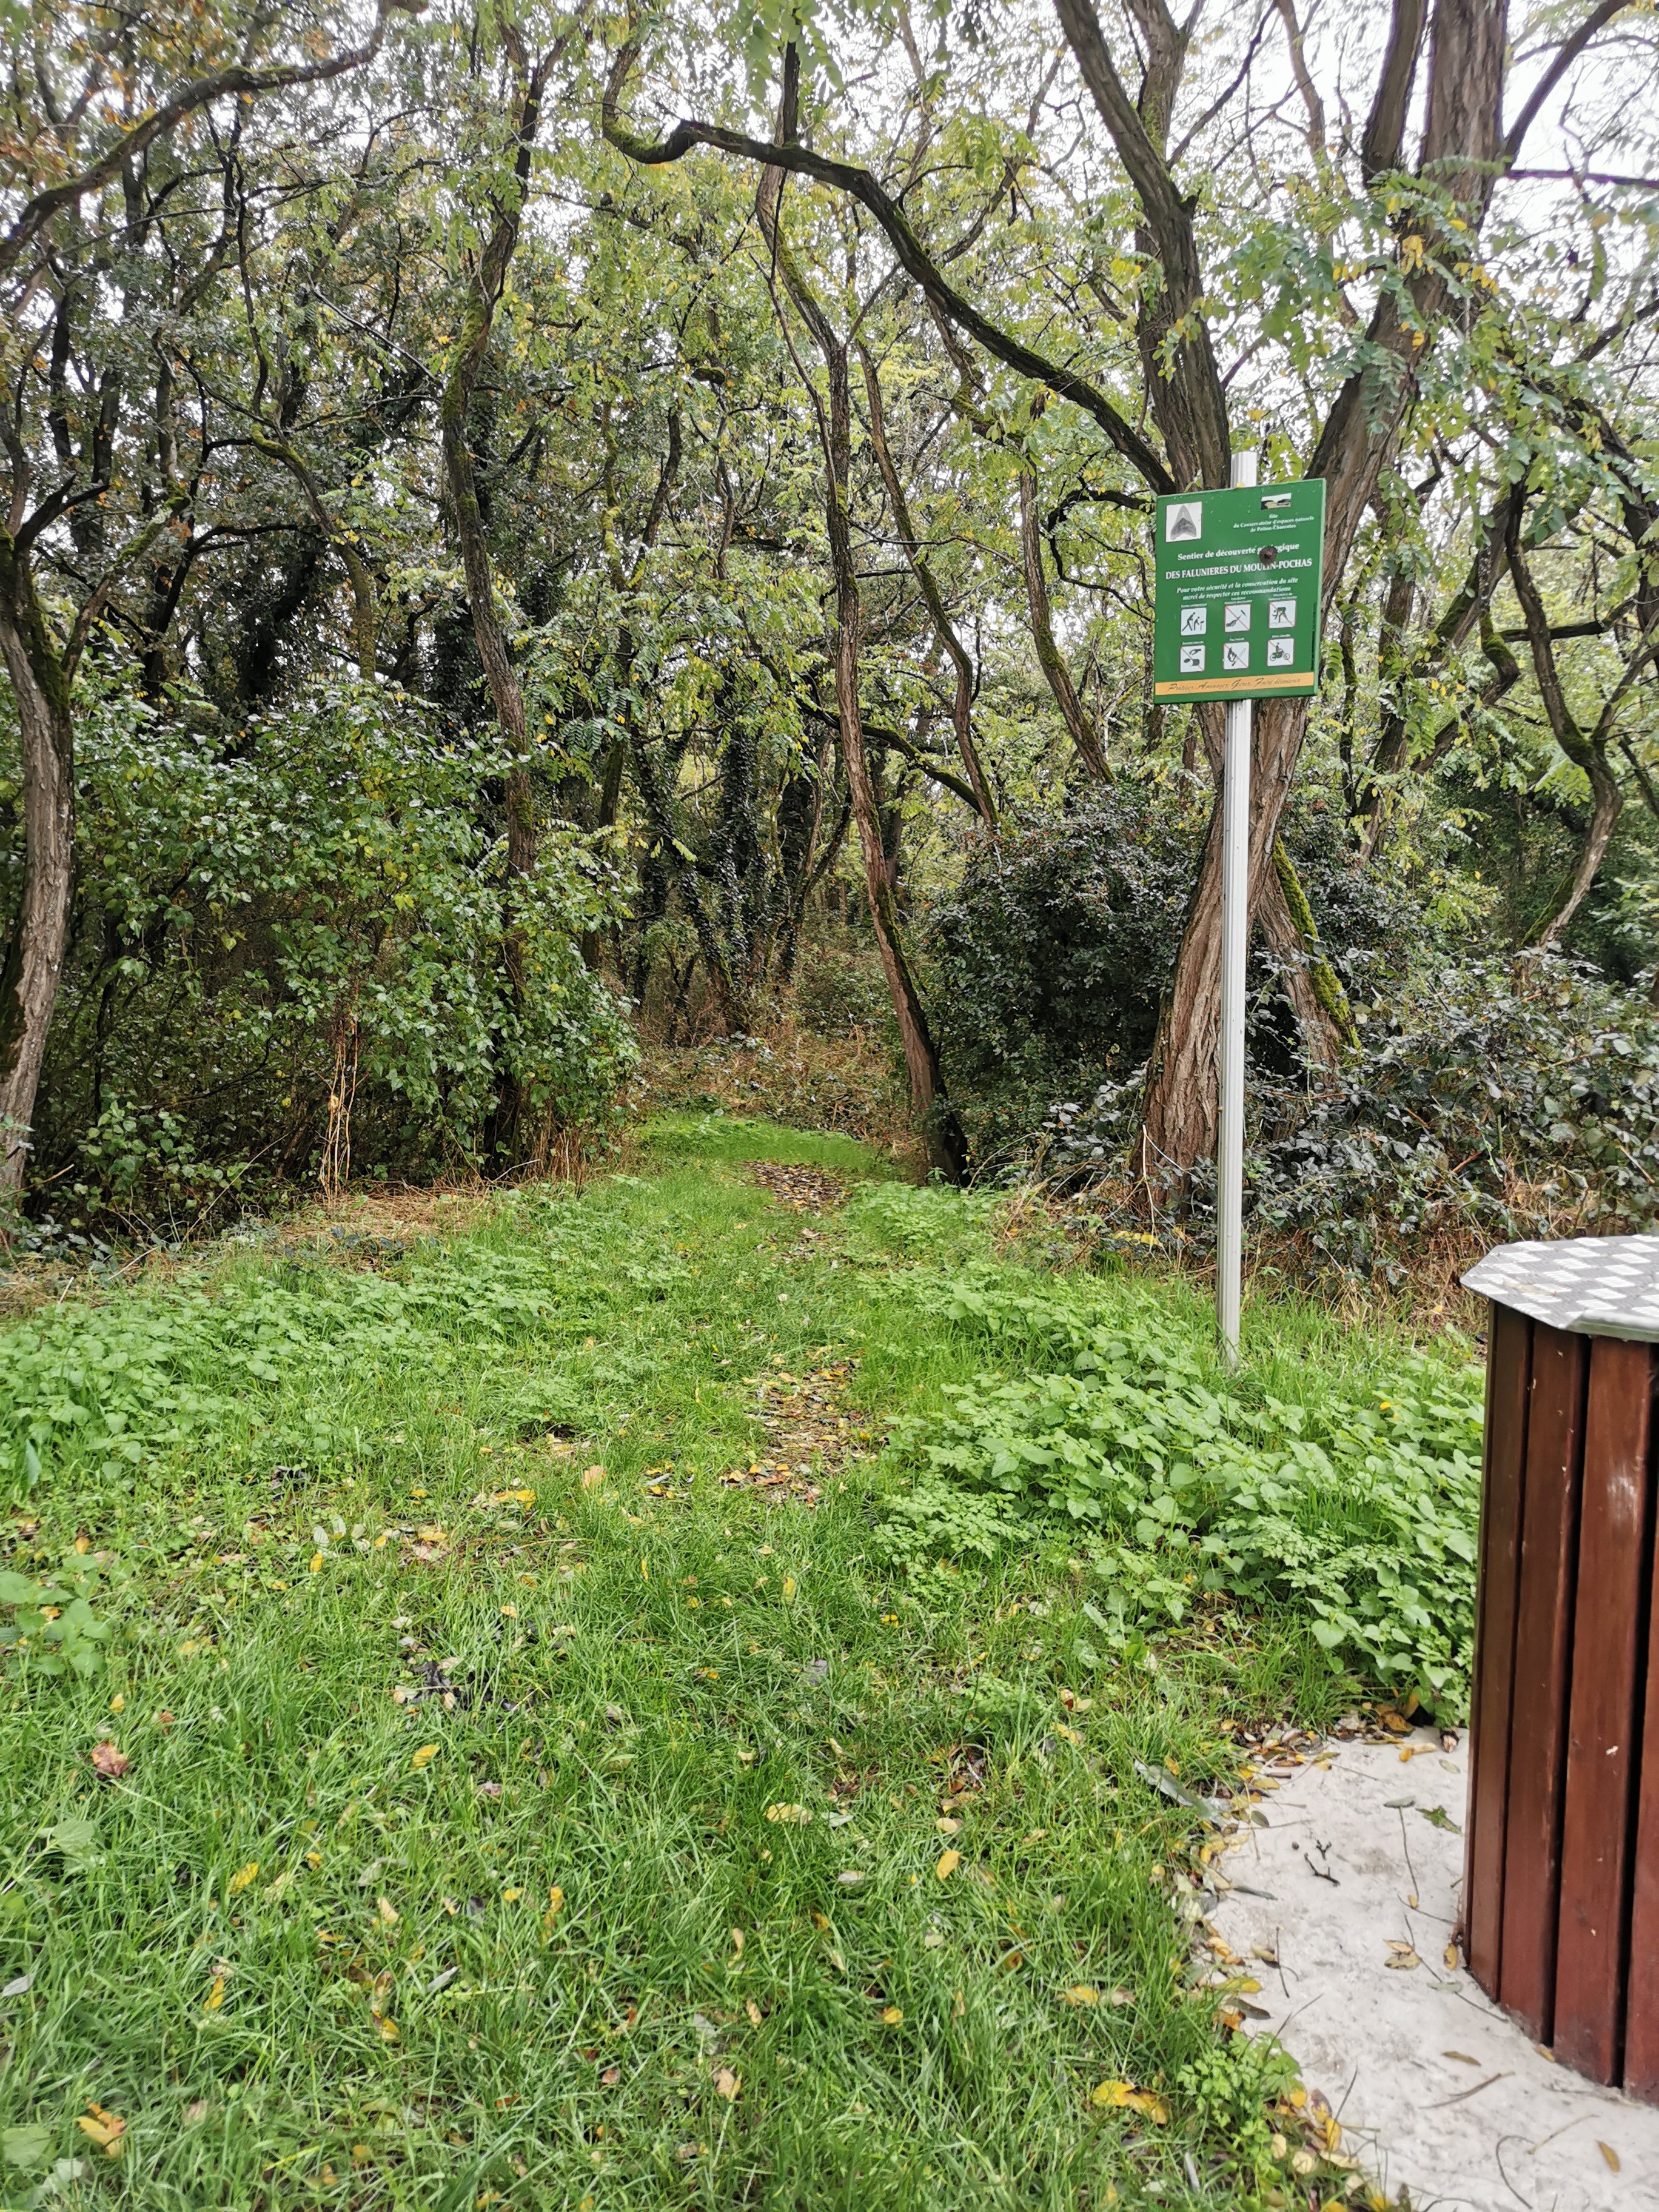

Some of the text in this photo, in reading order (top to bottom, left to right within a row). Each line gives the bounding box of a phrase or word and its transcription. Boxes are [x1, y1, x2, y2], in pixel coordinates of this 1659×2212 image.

[1205, 550, 1215, 558] de
[1216, 547, 1256, 557] découverte
[1257, 543, 1300, 555] gogique
[1165, 571, 1181, 580] DES
[1182, 566, 1228, 578] FALUNIERES
[1230, 565, 1242, 574] DU
[1241, 579, 1278, 588] conservation
[1241, 586, 1291, 595] recommandations
